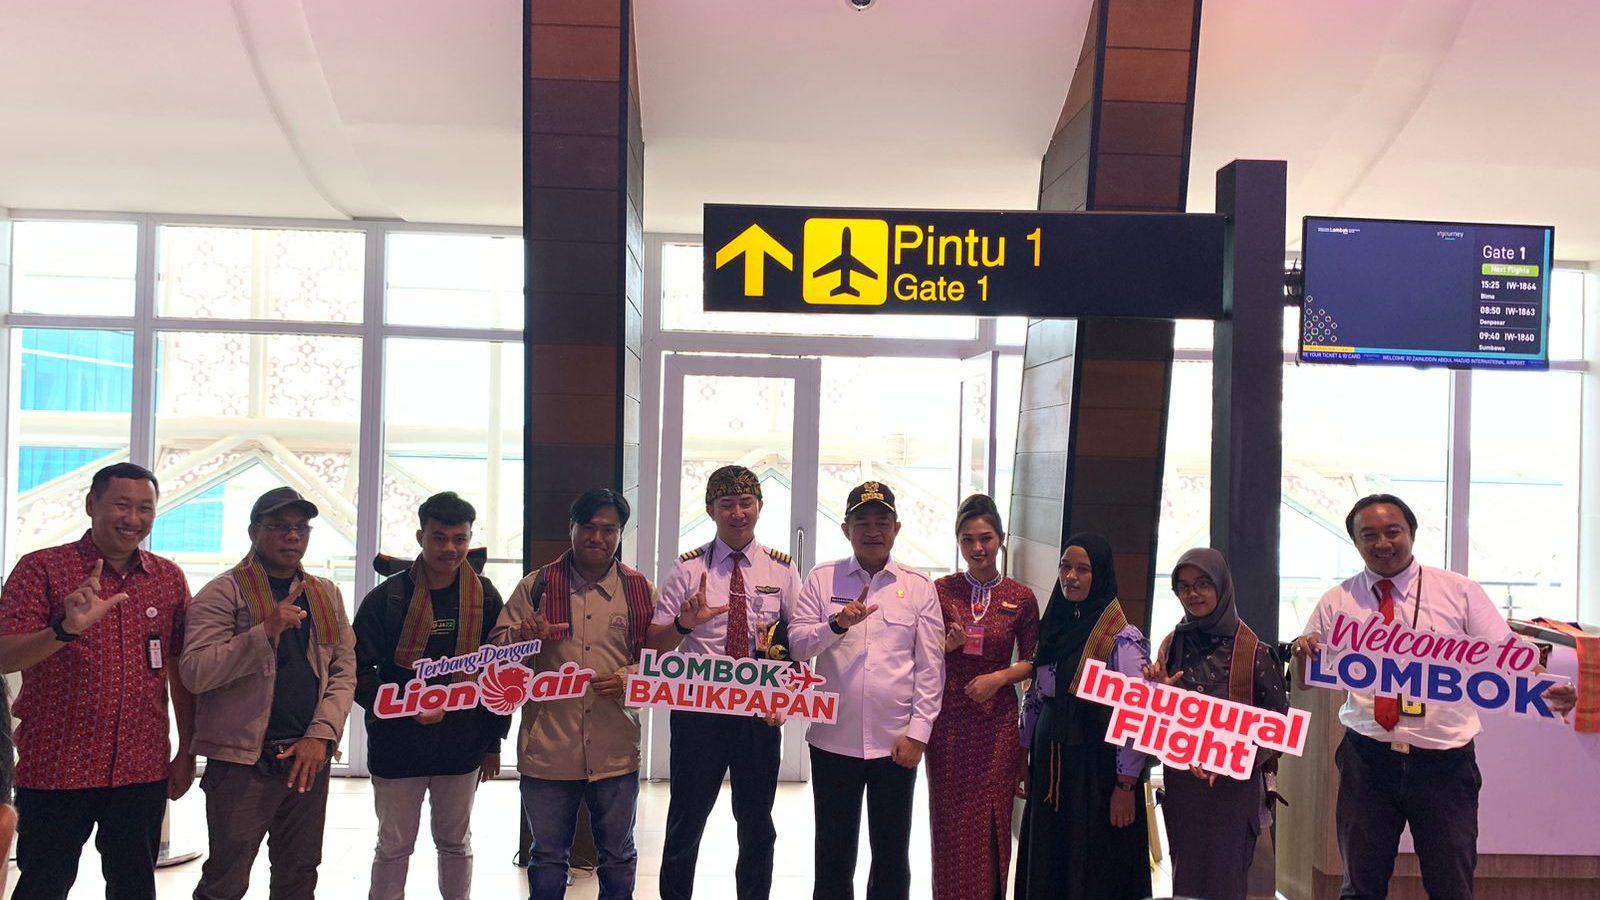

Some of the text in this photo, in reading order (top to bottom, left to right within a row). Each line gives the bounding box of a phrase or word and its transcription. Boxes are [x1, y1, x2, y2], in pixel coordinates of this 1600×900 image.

[894, 224, 1041, 268] Pintu 1
[1482, 245, 1526, 260] Gate 1
[893, 273, 988, 302] Gate 1
[1481, 280, 1537, 290] 15:25 IW-1864
[1491, 265, 1530, 275] Next Flights
[1480, 306, 1536, 316] 08:50 IW-1863
[1479, 331, 1535, 342] 09:40 IW-1860
[414, 640, 541, 680] Terbang Dengan
[1331, 614, 1535, 671] Welcome to
[377, 666, 593, 715] Lion air
[642, 653, 781, 688] LOMBOK
[1309, 649, 1557, 719] LOMBOK
[629, 679, 836, 720] BALIKPAPAN
[1082, 664, 1304, 749] Inaugural
[1111, 708, 1250, 775] Flight
